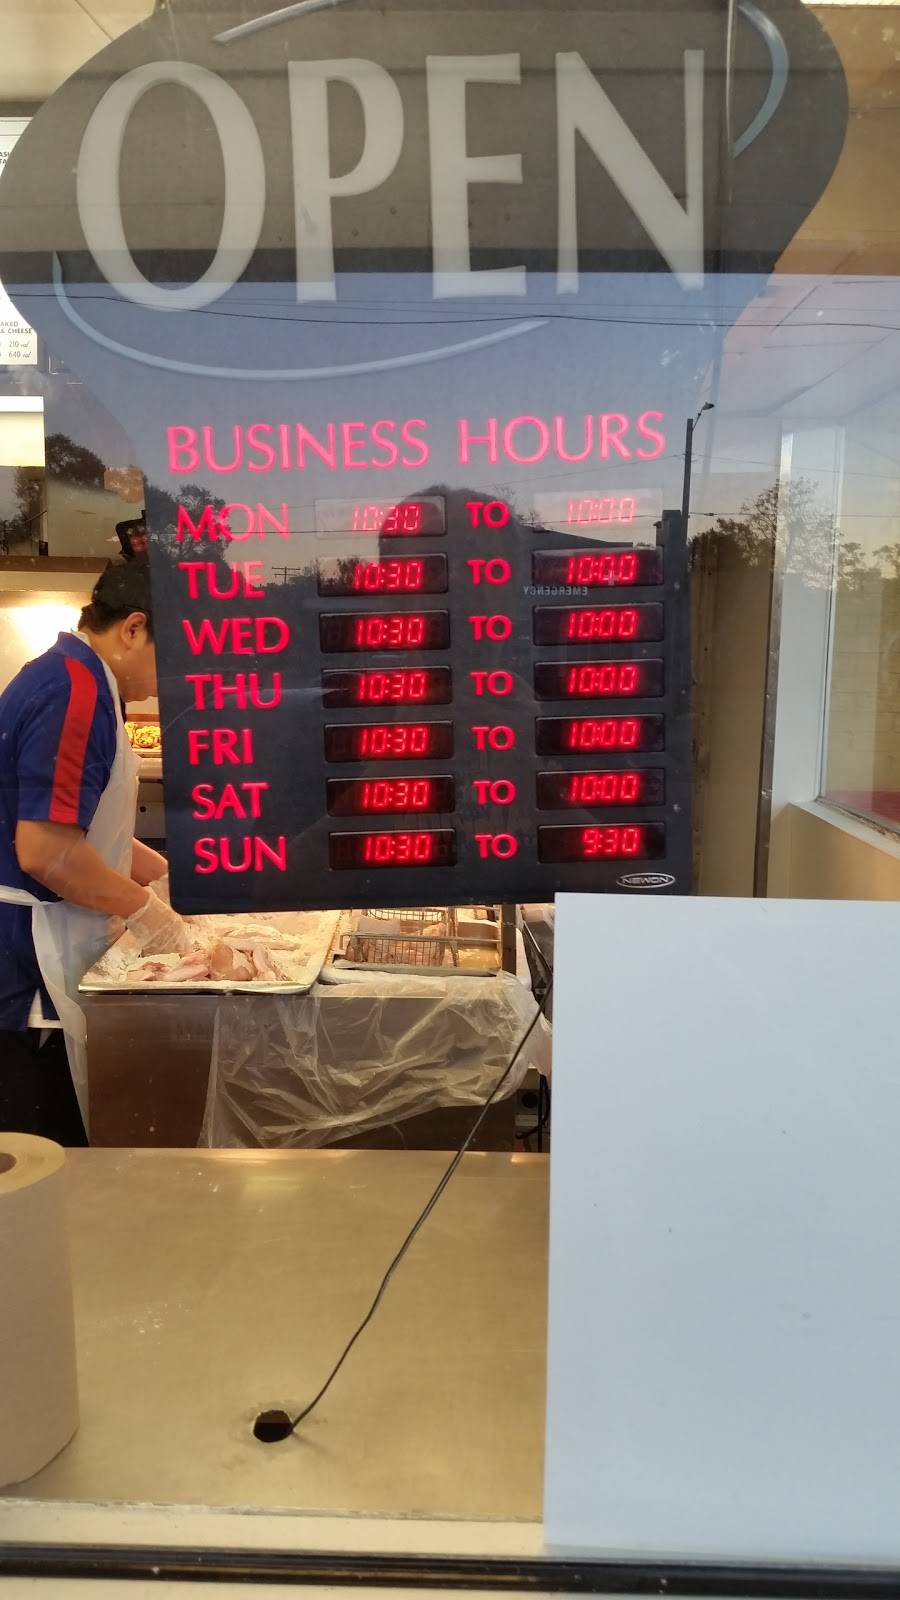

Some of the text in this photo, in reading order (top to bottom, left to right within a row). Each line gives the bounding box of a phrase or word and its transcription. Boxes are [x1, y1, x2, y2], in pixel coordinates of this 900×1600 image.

[76, 49, 705, 311] OPEN
[8, 340, 20, 348] 210
[8, 350, 21, 359] 640
[166, 410, 667, 474] BUSINESS HOURS
[175, 497, 638, 544] MON 10:30 TO 10:00
[177, 552, 640, 601] TUE 10:30 TO 10:00
[181, 607, 640, 657] WED 10:30 TO 10:00
[184, 663, 640, 712] THU 10:30 TO 10:00
[187, 717, 641, 767] FRI 10:30 TO 10:00
[190, 771, 642, 822] SAT 10:30 TO 10:00
[193, 825, 644, 875] SUN 10:30 TO 9:30
